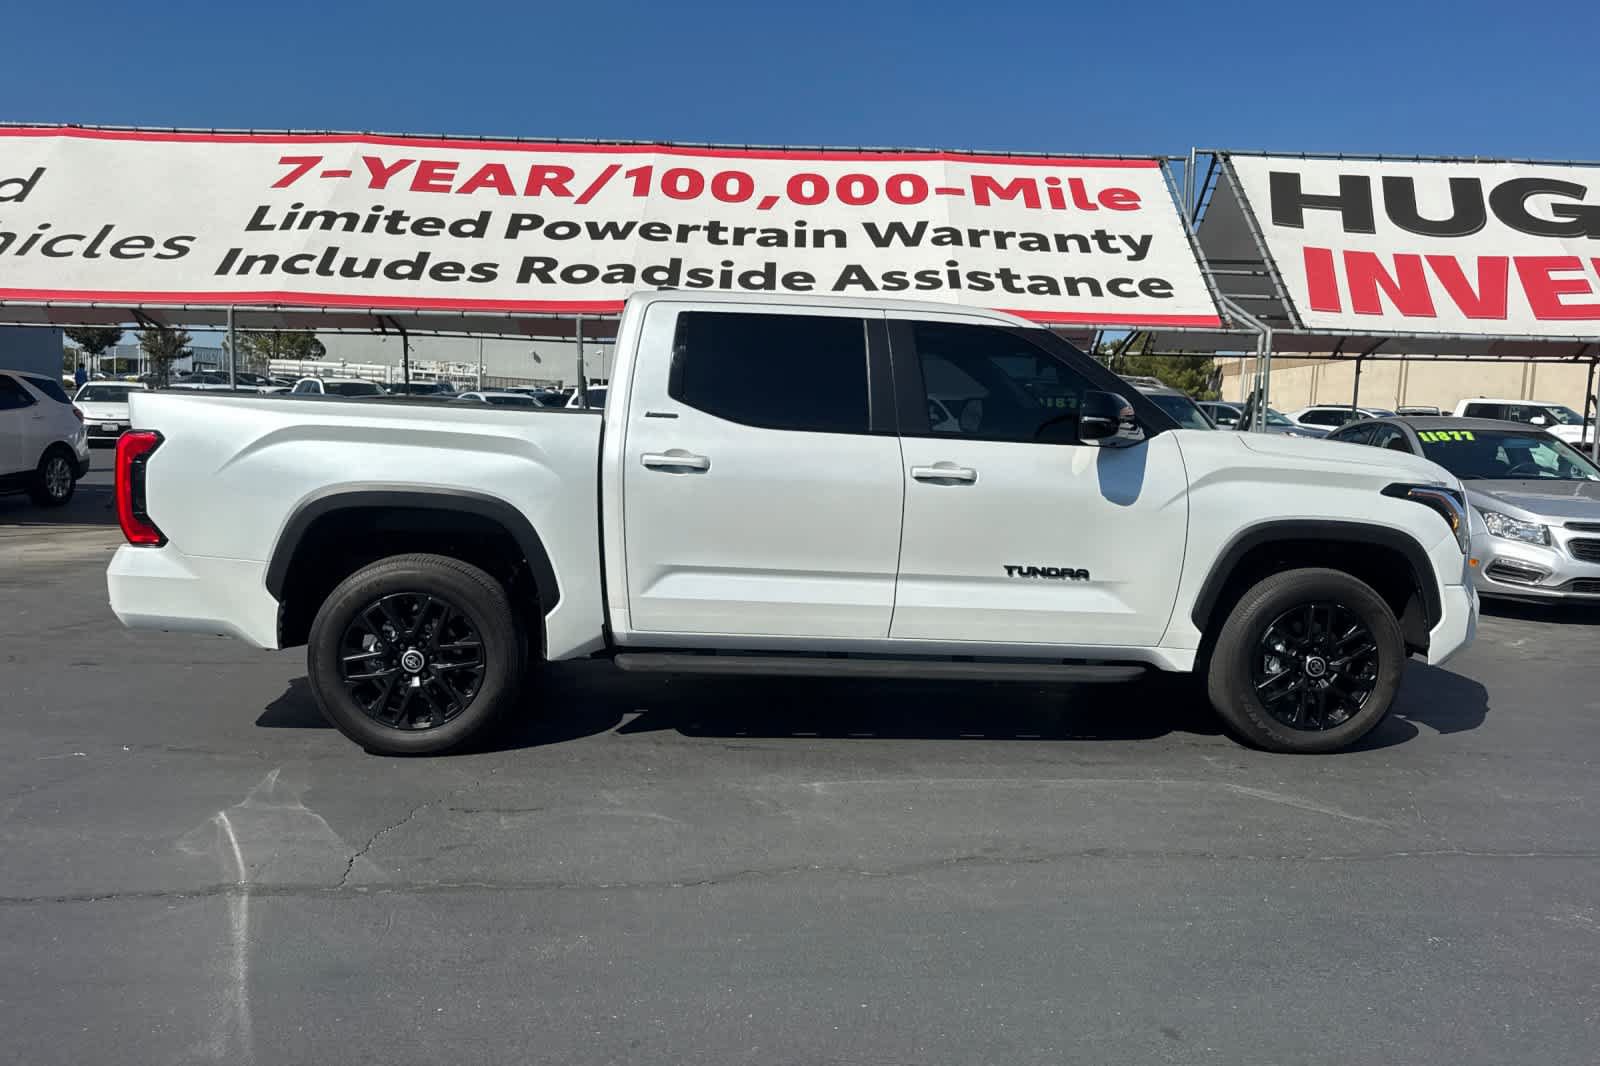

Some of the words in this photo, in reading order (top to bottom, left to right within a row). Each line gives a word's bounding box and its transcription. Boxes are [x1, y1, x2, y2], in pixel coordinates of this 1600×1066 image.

[270, 154, 1141, 211] 7-YEAR/100,000-Mile
[1269, 171, 1600, 240] HUG
[244, 202, 493, 239] Limited
[503, 213, 847, 249] Powertrain
[861, 220, 1153, 262] Warranty
[213, 246, 500, 283] Includes
[515, 255, 816, 292] Roadside
[831, 259, 1174, 297] Assistance
[1303, 246, 1600, 321] INVE
[1418, 431, 1475, 442] 11877
[1003, 565, 1090, 581] TUNDRA
